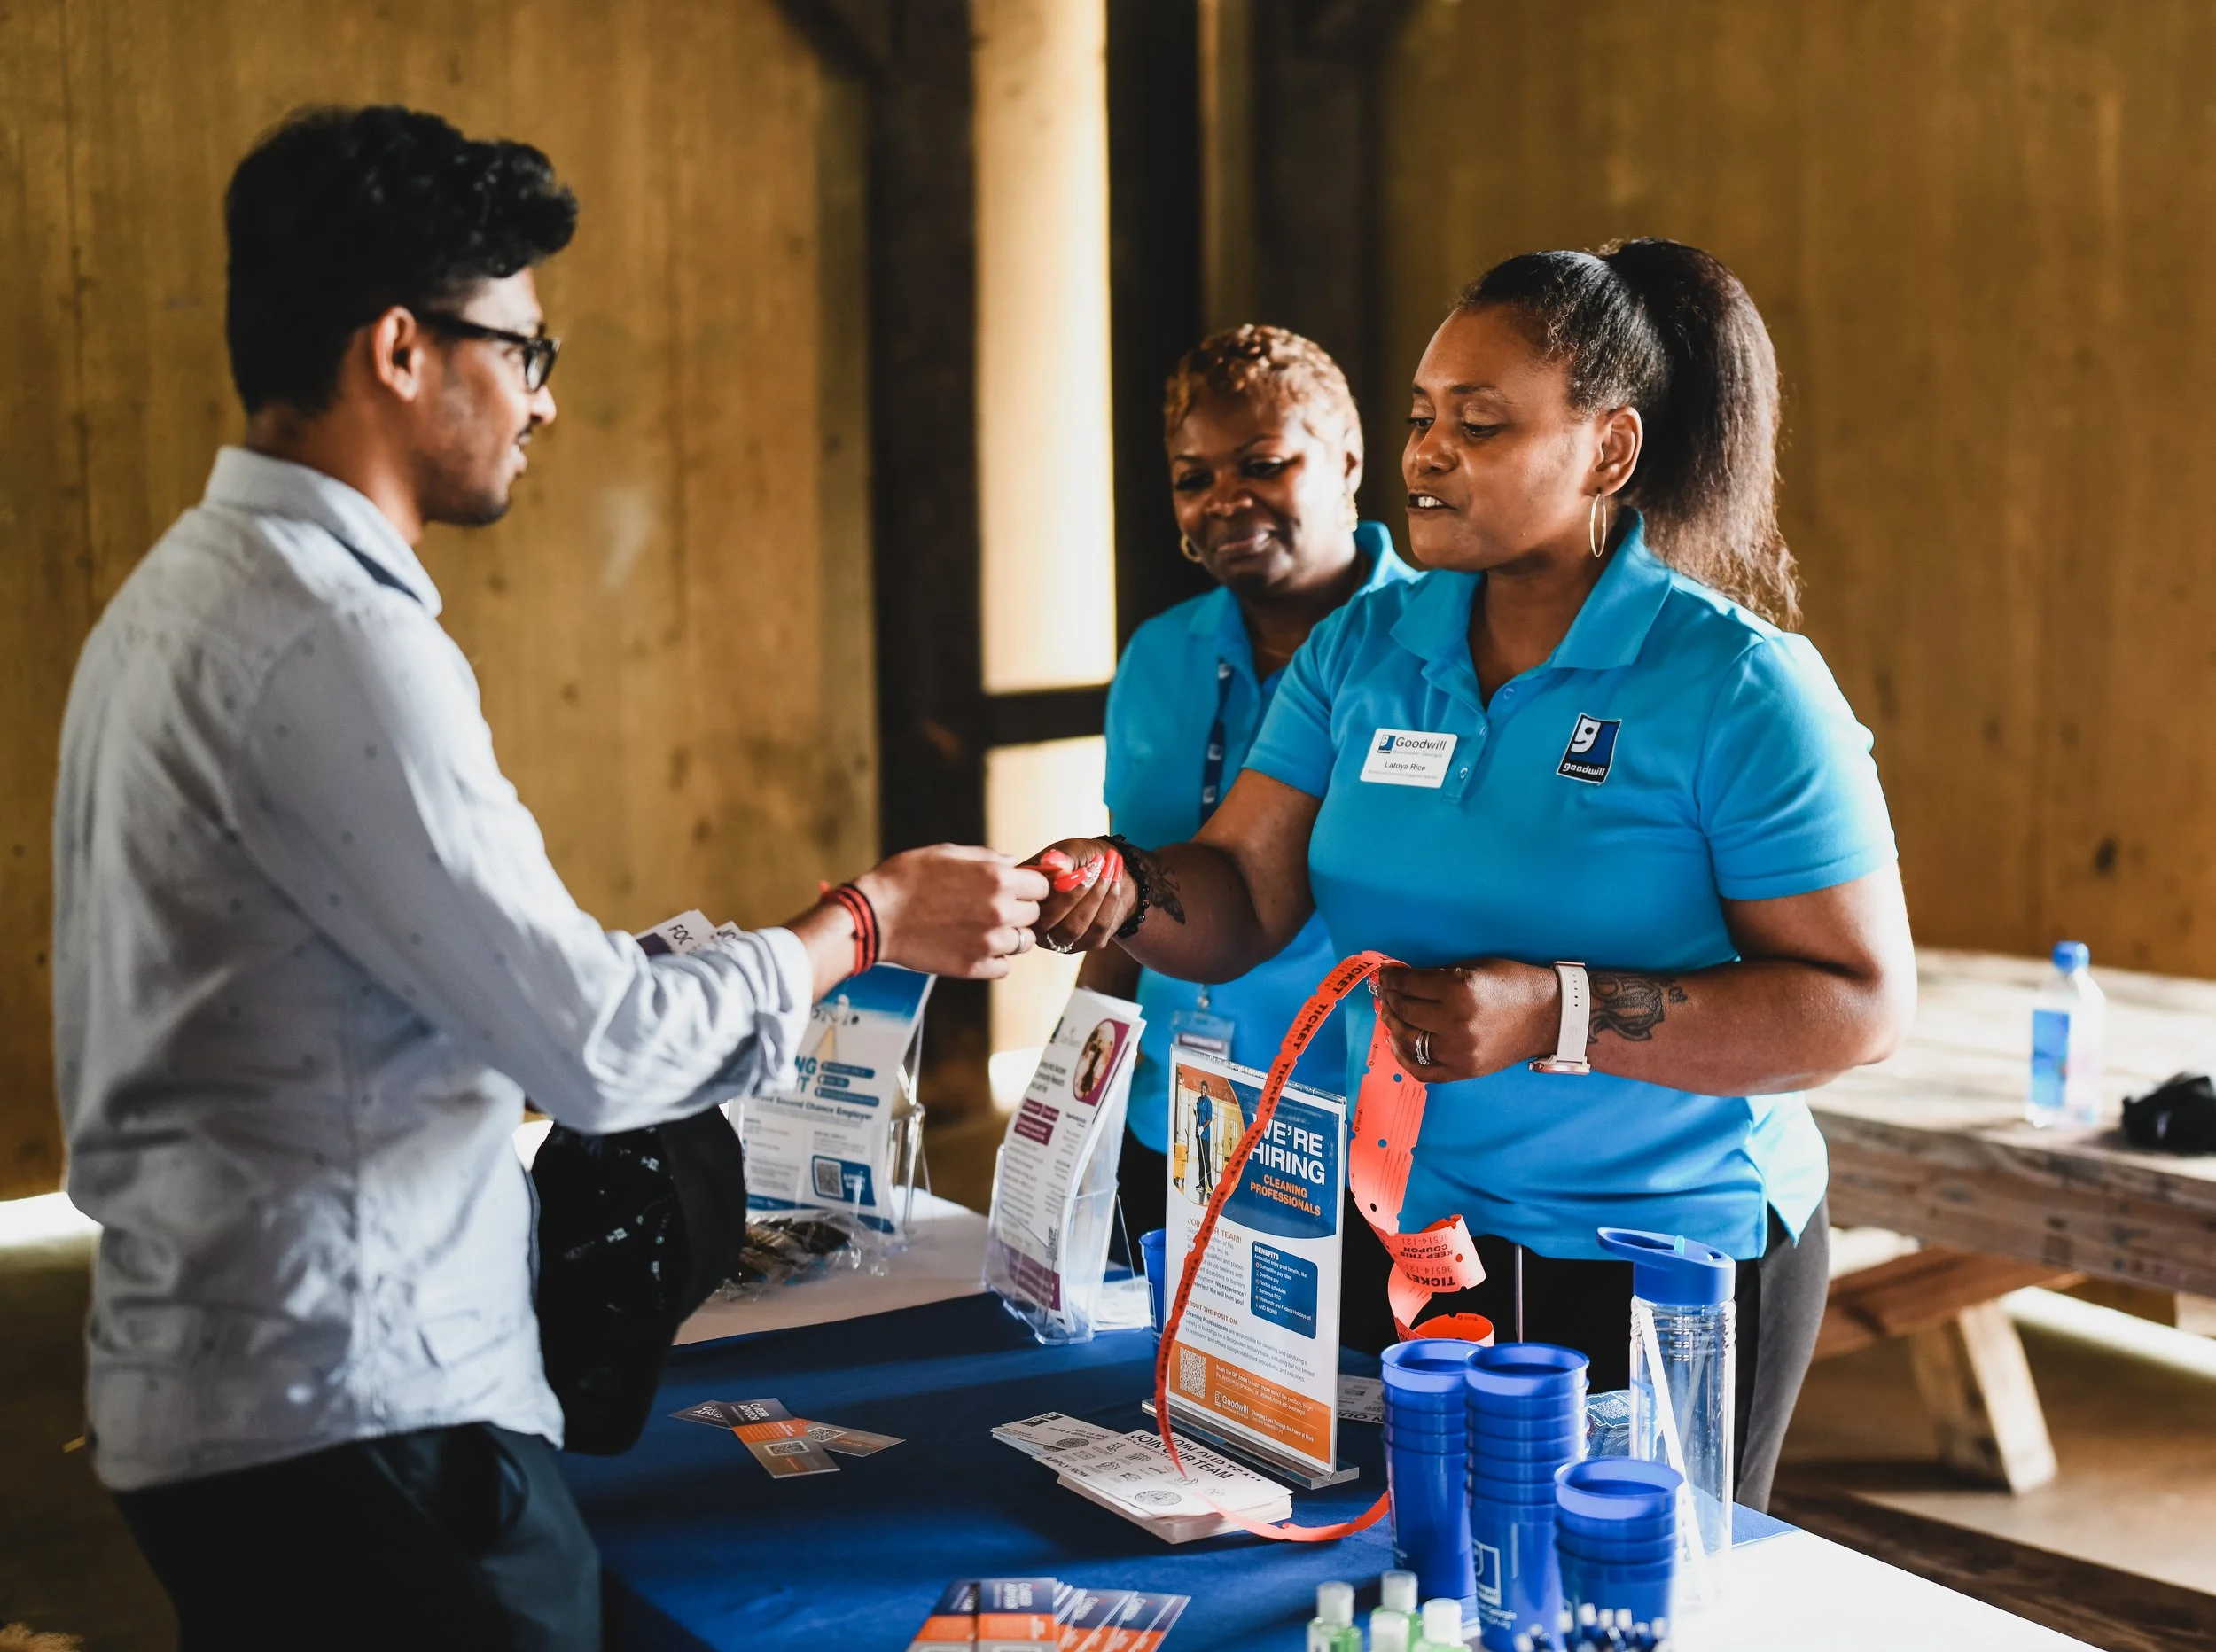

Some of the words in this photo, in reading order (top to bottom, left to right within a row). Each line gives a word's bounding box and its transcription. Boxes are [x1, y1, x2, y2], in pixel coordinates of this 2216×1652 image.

[1395, 736, 1447, 751] Goodwill
[1385, 761, 1408, 770] Latoya
[1563, 762, 1605, 776] goodwill
[1332, 961, 1374, 994] TICKET
[1293, 1003, 1329, 1050] TICKET
[1265, 1062, 1291, 1115] TICKET
[806, 1101, 834, 1113] Chance
[837, 1106, 872, 1121] Employer
[1230, 1128, 1262, 1178] TICKET
[1248, 1142, 1325, 1186] HIRING
[1263, 1174, 1307, 1198] CLEANING
[1250, 1181, 1321, 1216] PROFESSIONALS
[1221, 1229, 1242, 1243] TEAM!
[1254, 1245, 1279, 1260] BENEFITS
[1426, 1250, 1453, 1259] KEEP
[1259, 1263, 1276, 1274] Competitive
[1259, 1271, 1273, 1281] Overtime
[1406, 1272, 1455, 1287] TICKET
[1221, 1284, 1246, 1297] experience?
[1189, 1300, 1202, 1311] BOUT
[1204, 1305, 1213, 1315] THE
[1213, 1311, 1237, 1325] POSITION
[1281, 1305, 1292, 1313] Federal
[1186, 1309, 1202, 1321] Cleaning
[1203, 1316, 1229, 1332] Professionals
[1222, 1395, 1249, 1414] Goodwill
[1131, 1434, 1166, 1448] JOIN
[1192, 1459, 1234, 1479] TEAM
